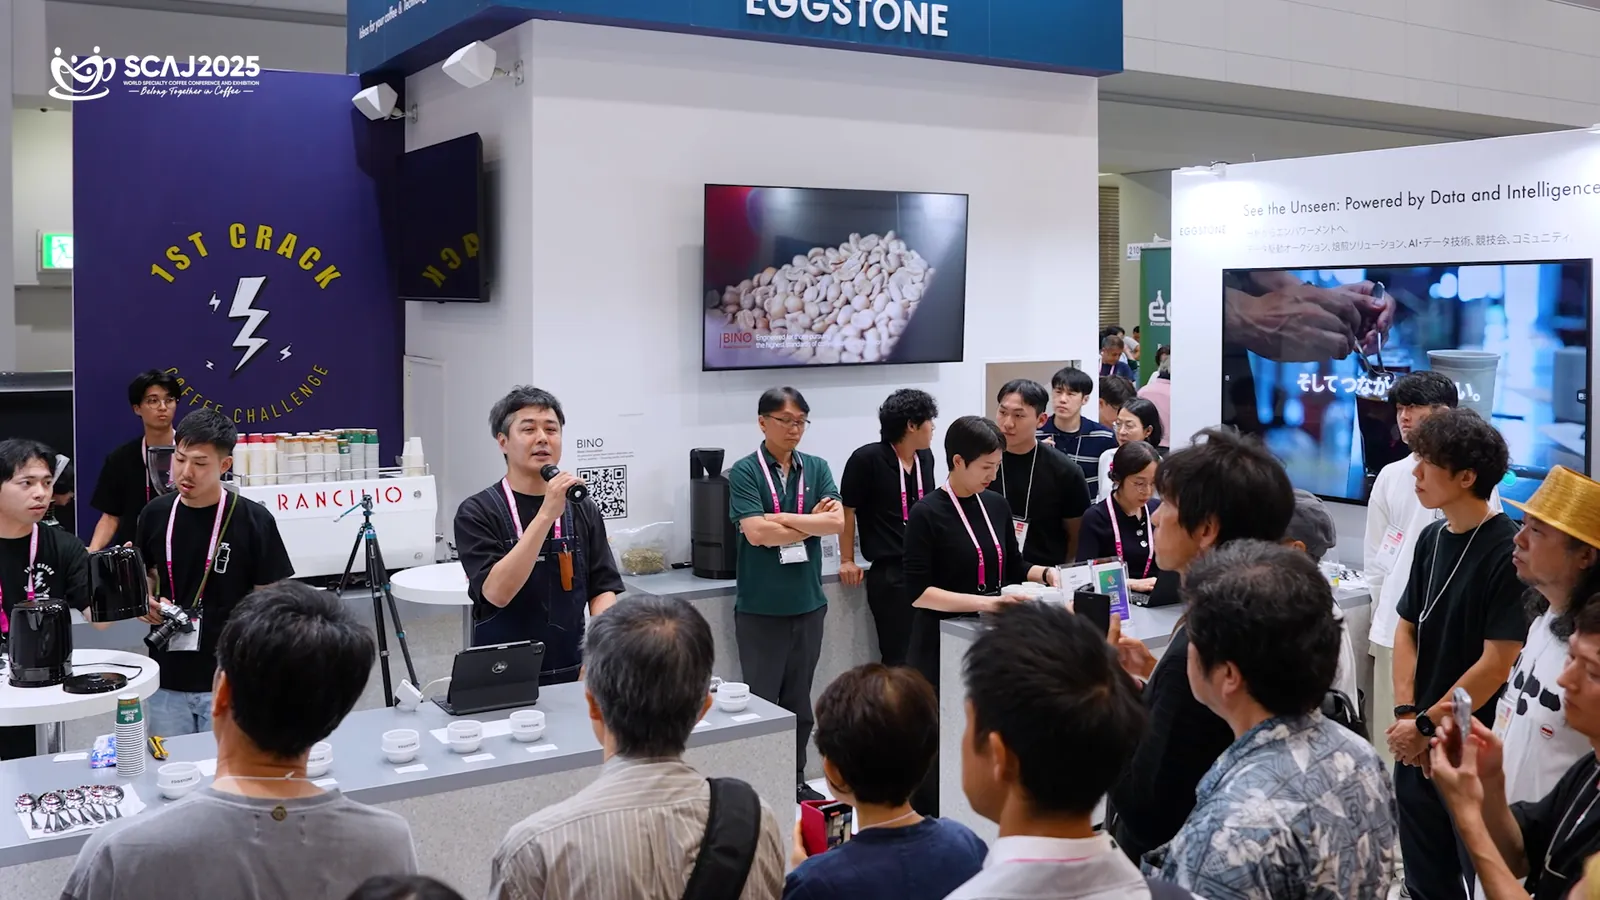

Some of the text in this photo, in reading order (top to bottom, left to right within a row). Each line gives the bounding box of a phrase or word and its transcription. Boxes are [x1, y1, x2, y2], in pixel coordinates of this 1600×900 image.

[1243, 181, 1600, 217] See the Unseen: Powered by Data and Intelligence
[150, 223, 342, 289] 1ST CRACK
[233, 364, 329, 424] CHALLENGE
[576, 437, 604, 449] BINO
